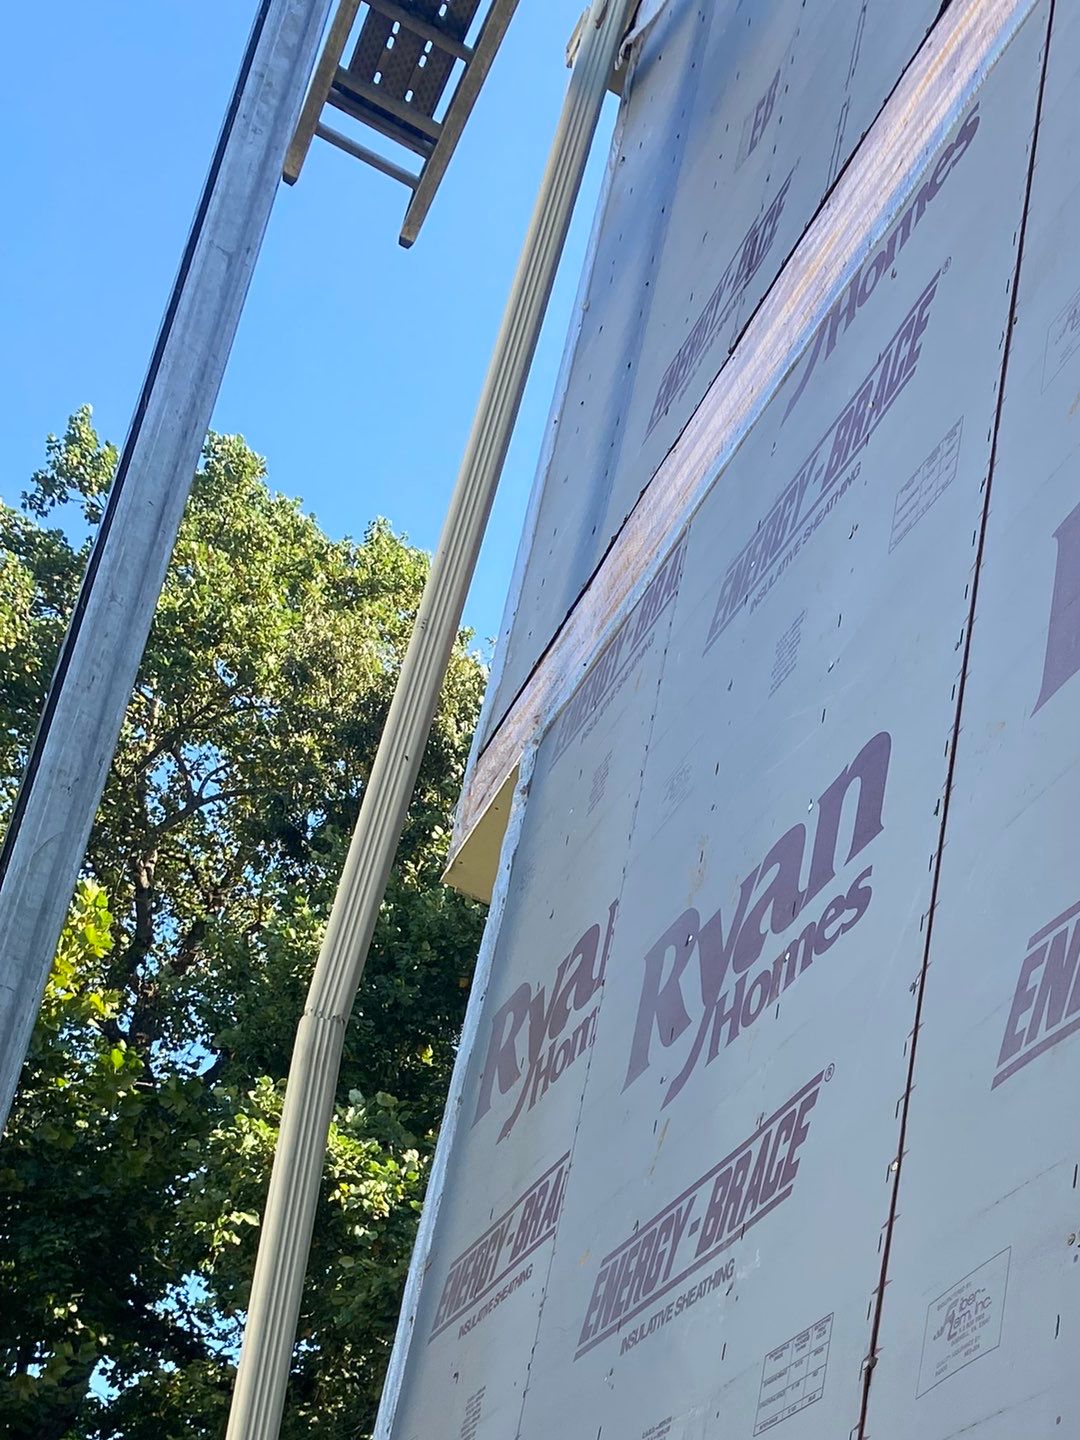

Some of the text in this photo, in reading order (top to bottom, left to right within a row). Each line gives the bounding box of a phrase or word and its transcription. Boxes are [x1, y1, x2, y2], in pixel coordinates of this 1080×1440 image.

[824, 101, 980, 362] Homes
[706, 282, 938, 646] ENERGY-BRACE
[620, 732, 892, 1112] Ryan
[705, 865, 872, 1068] Homes
[577, 1087, 820, 1347] ENERGY-BRACE
[674, 1258, 735, 1317] SHEATHING
